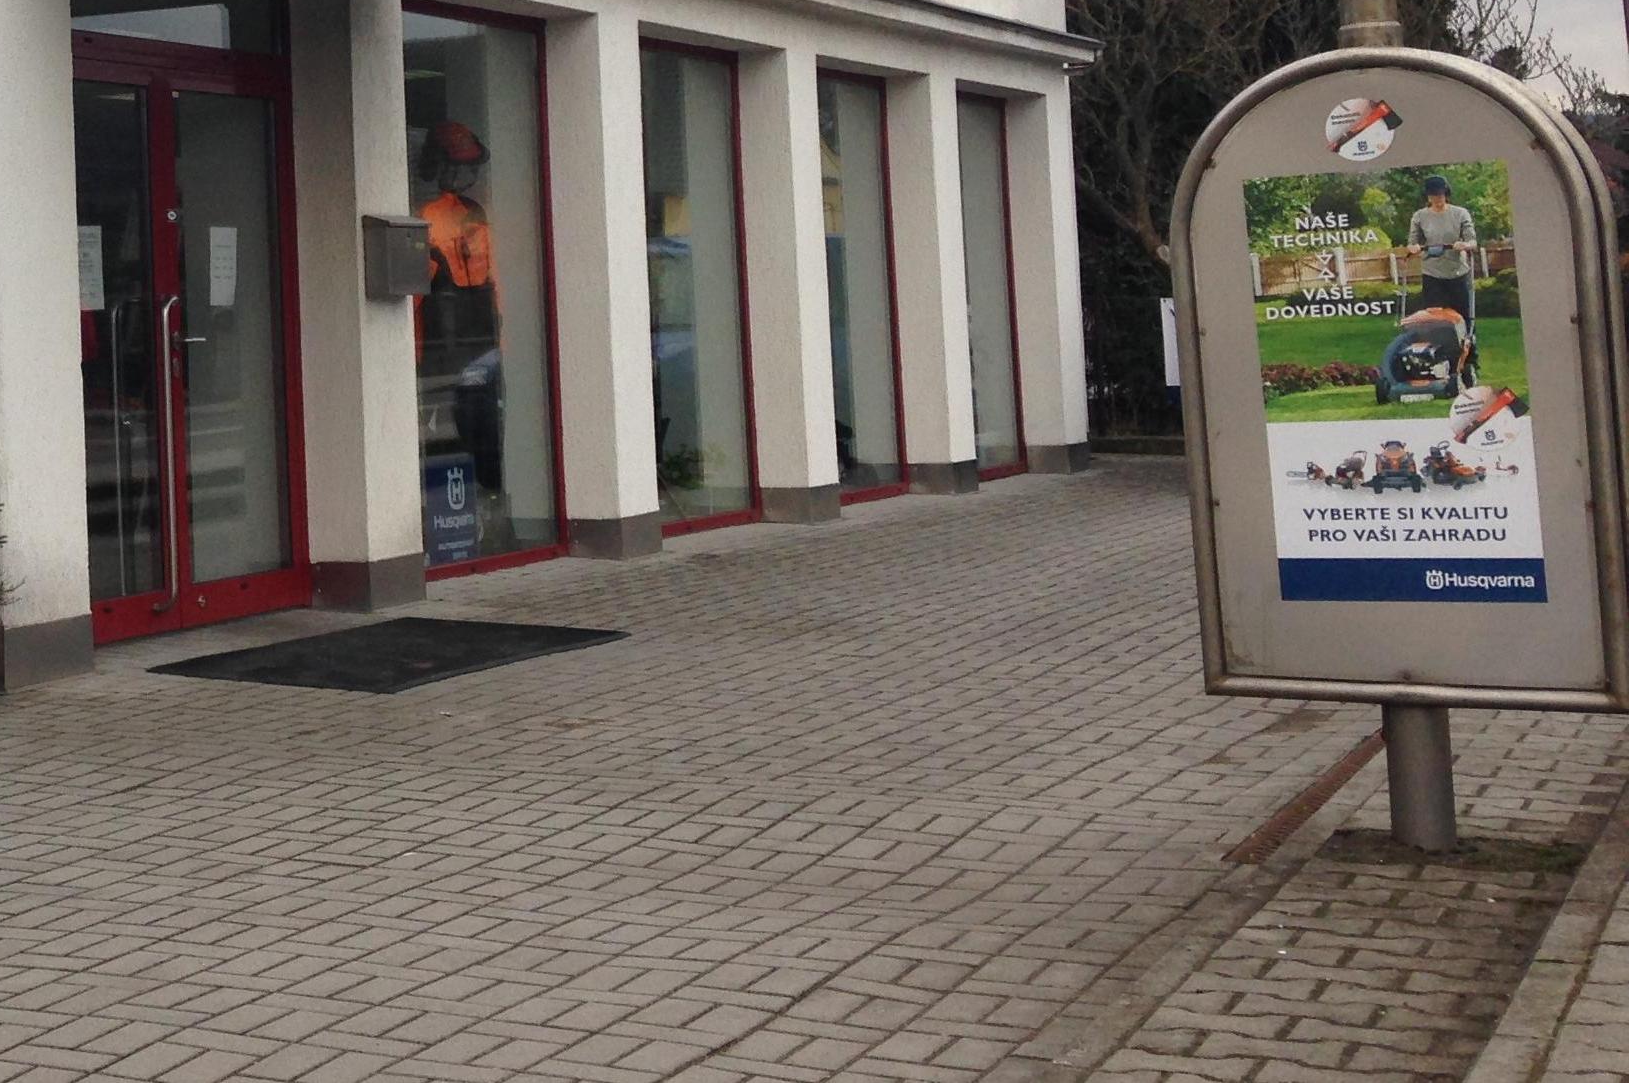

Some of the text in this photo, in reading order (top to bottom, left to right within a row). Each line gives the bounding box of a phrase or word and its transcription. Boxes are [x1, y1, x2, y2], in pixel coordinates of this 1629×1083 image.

[1295, 211, 1350, 230] NAŠE
[1270, 229, 1379, 248] TECHNIKA
[1303, 284, 1354, 301] VAŠE
[1266, 301, 1395, 320] DOVEDNOST
[1303, 506, 1508, 521] VYBERTE SI KVALITU
[1308, 525, 1507, 542] PRO VAŠI ZAHRADU
[1445, 572, 1535, 590] Husqvarna
